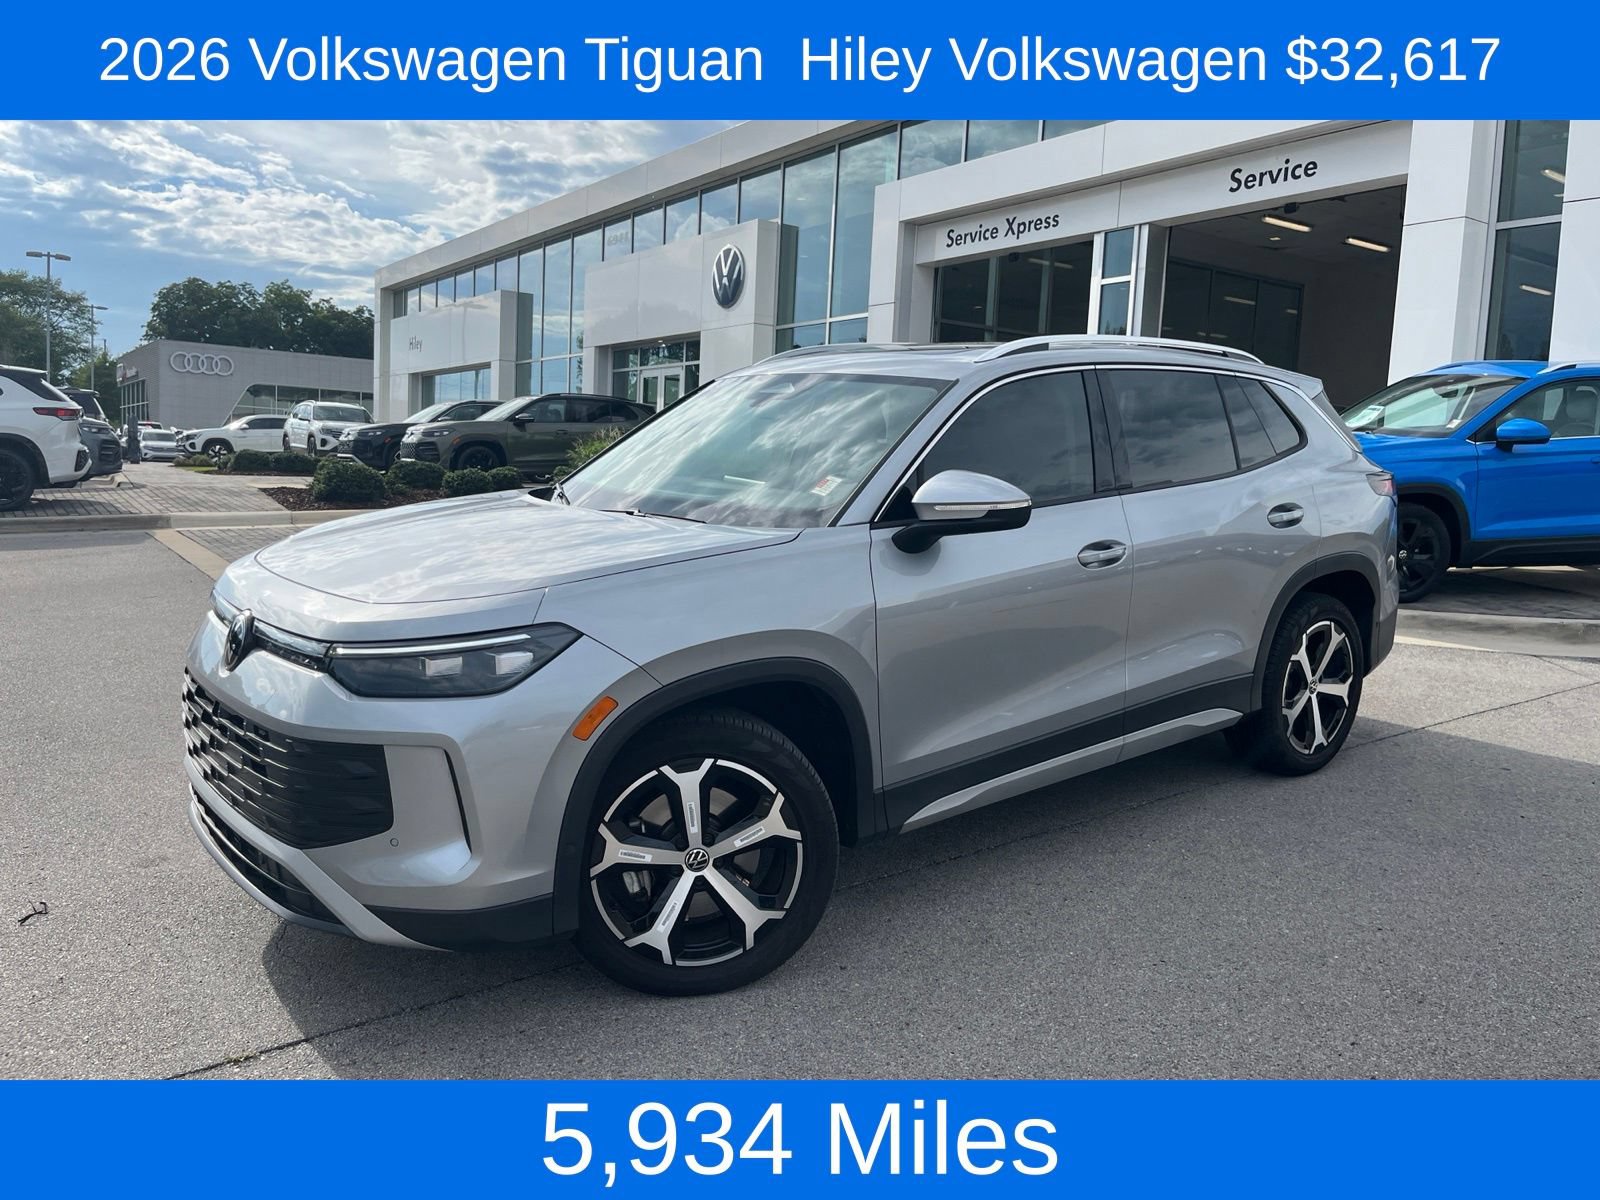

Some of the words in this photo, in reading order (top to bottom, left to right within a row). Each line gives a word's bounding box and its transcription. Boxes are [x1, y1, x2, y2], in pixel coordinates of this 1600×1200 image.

[1228, 157, 1319, 194] Service
[945, 223, 999, 248] Service
[1003, 214, 1060, 240] Xpress
